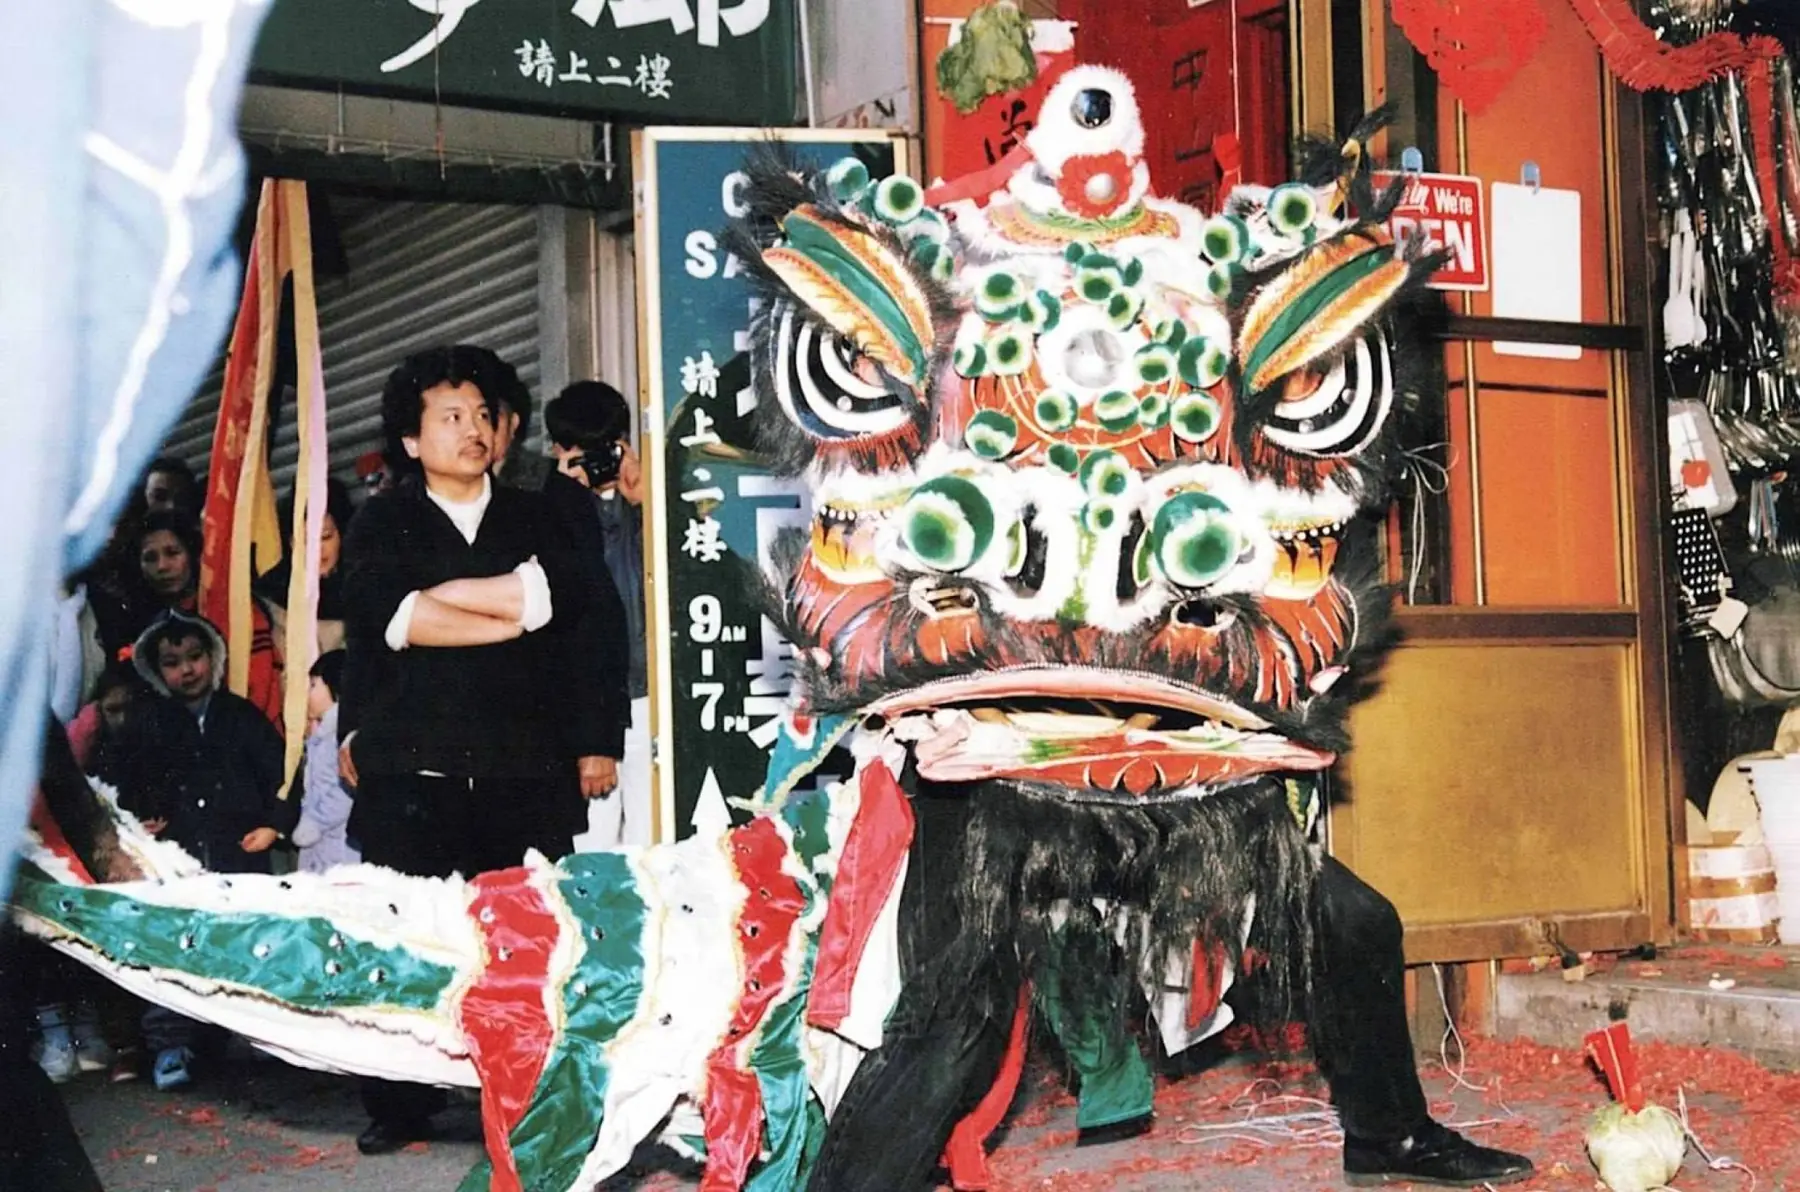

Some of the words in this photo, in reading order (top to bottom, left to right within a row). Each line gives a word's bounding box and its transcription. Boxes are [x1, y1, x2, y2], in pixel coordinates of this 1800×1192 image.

[514, 38, 673, 99] 請上二樓
[1433, 187, 1474, 215] We're
[1381, 216, 1475, 273] PEN
[680, 350, 728, 563] 請上二樓
